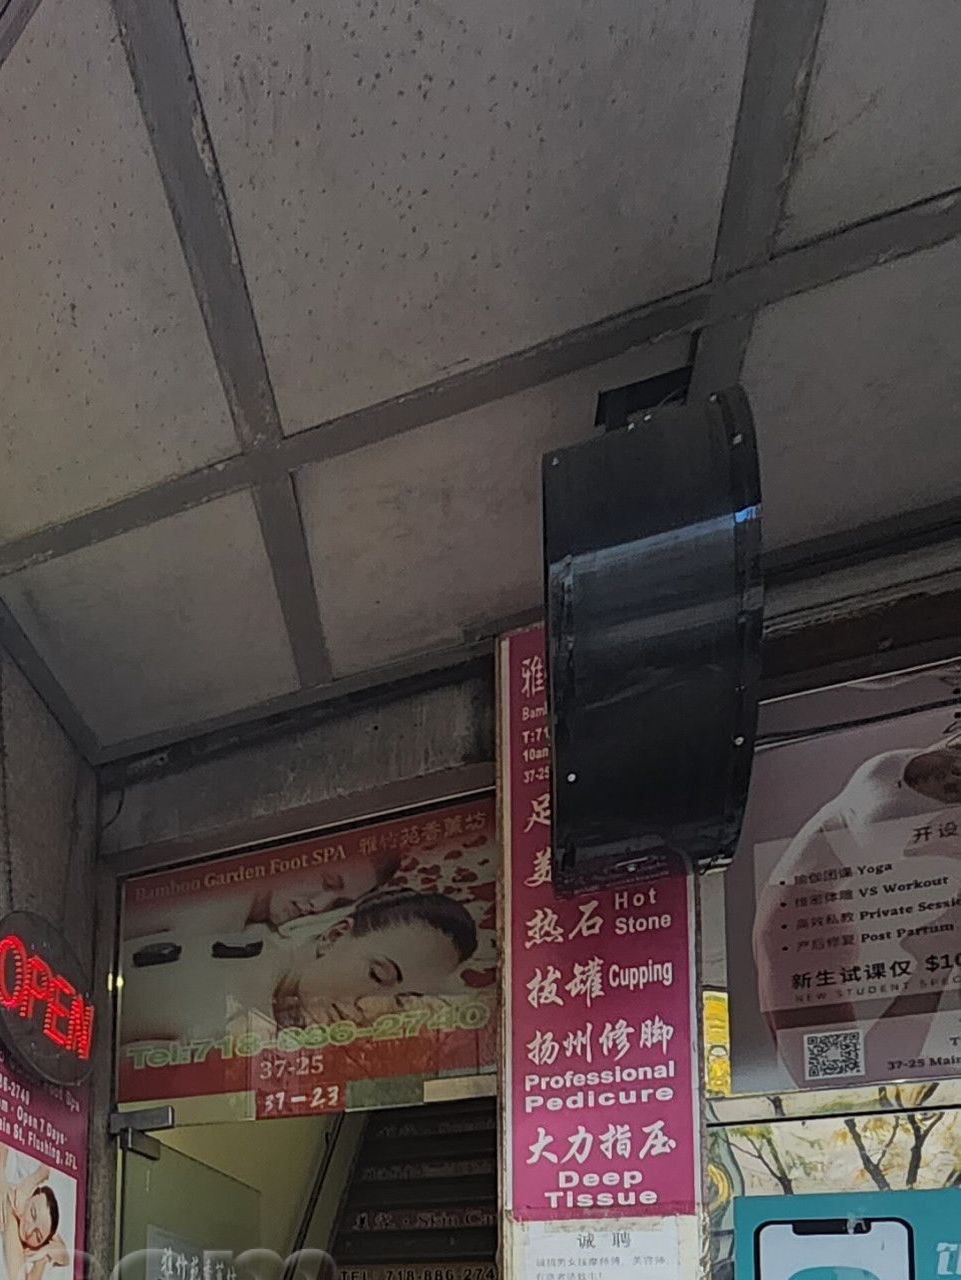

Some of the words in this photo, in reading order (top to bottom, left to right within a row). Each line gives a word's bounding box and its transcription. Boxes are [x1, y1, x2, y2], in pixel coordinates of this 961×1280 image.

[134, 876, 201, 902] Bamboo
[204, 864, 266, 888] Garden
[269, 854, 310, 876] Foot
[312, 844, 346, 866] SPA
[857, 862, 893, 877] Yoga
[615, 887, 657, 911] Hot
[858, 886, 878, 898] VS
[883, 875, 949, 894] Workout
[524, 899, 604, 950] 热石
[615, 911, 672, 936] Stone
[859, 905, 914, 921] Private
[861, 929, 892, 944] Post
[896, 922, 955, 939] Partum
[526, 955, 604, 1008] 拔罐
[609, 958, 673, 989] Cupping
[791, 959, 912, 990] 新生试课仅
[836, 981, 911, 998] STUDENT
[525, 1015, 674, 1066] 扬州修脚
[259, 1054, 324, 1080] 37-25
[525, 1060, 675, 1091] Professional
[525, 1086, 674, 1113] Pedicure
[27, 1131, 64, 1166] Flushing,
[64, 1150, 78, 1170] 2FL
[525, 1119, 676, 1166] 大力指压
[558, 1169, 643, 1189] Deep
[544, 1189, 658, 1209] Tissue
